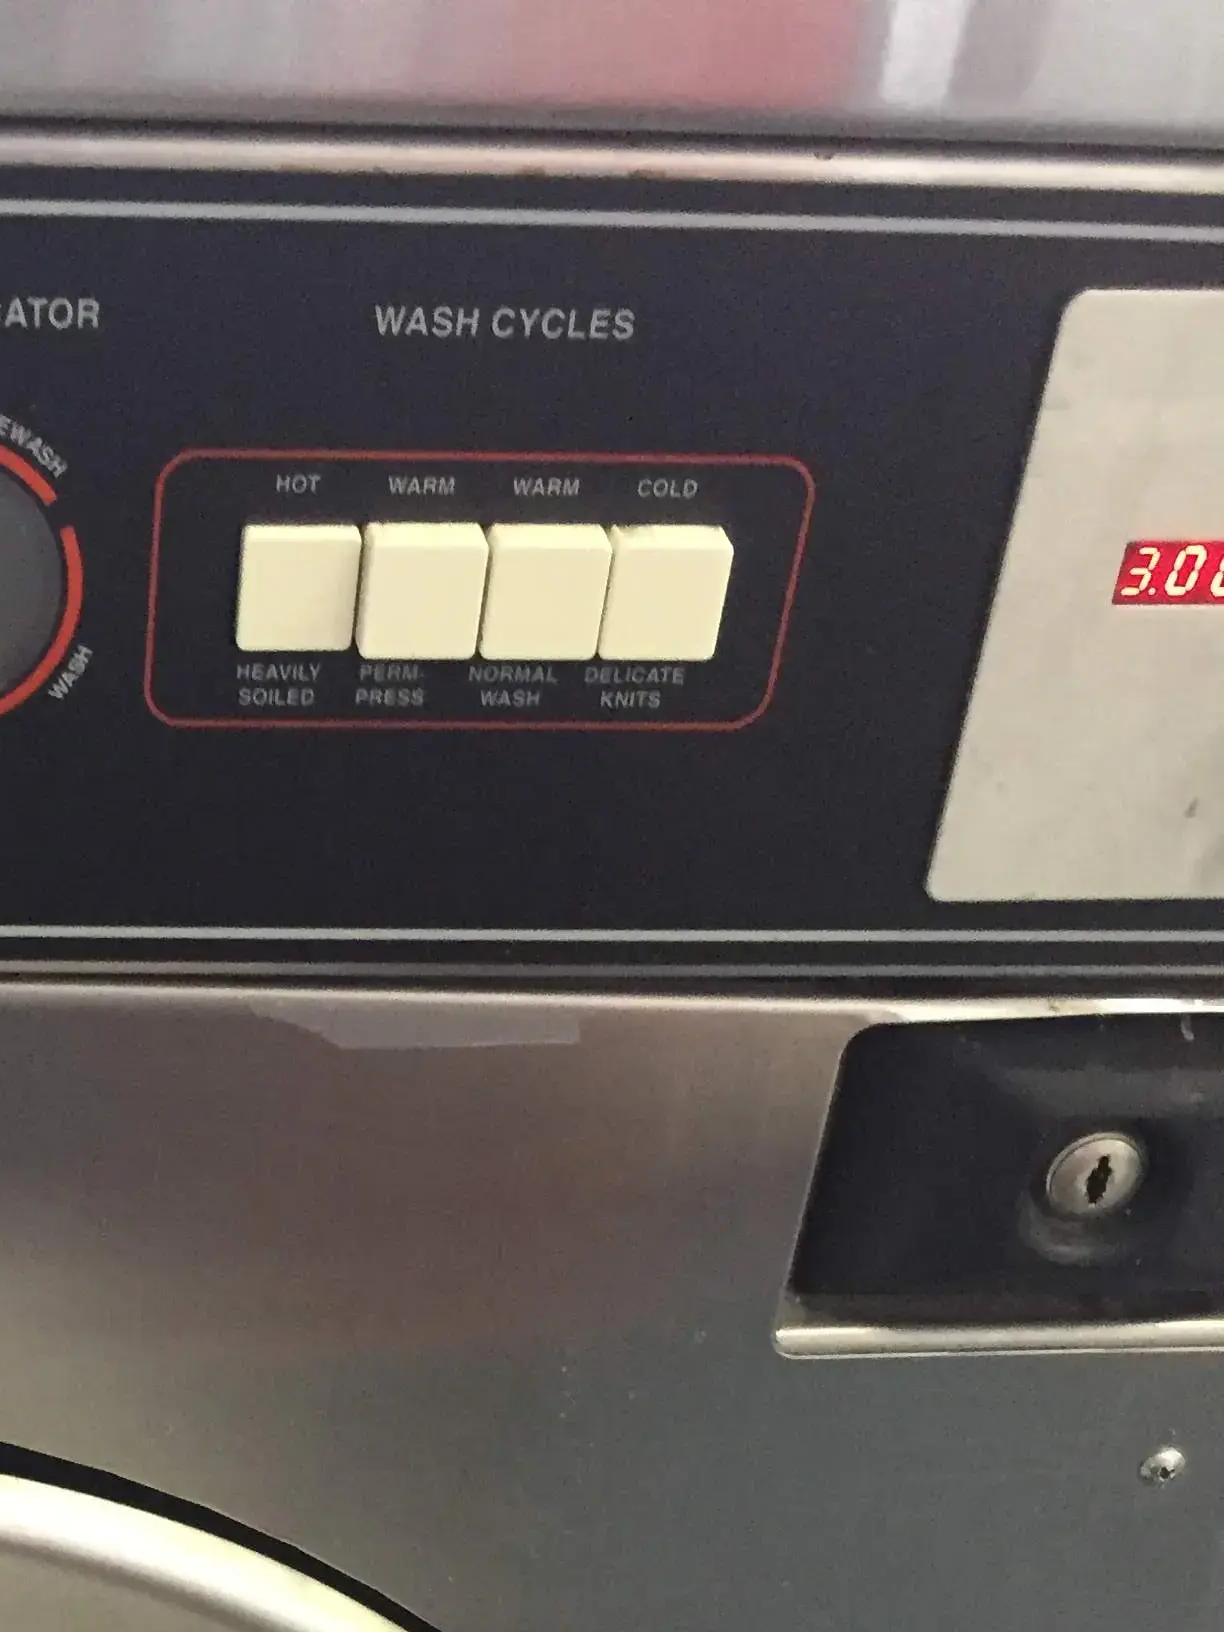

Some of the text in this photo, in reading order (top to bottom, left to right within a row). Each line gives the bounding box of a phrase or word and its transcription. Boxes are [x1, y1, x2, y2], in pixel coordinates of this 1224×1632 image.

[374, 305, 636, 341] WASH CYCLES
[276, 473, 321, 495] HOT
[388, 475, 456, 496] WARM
[513, 476, 580, 497] WARM
[637, 478, 698, 499] COLD
[47, 644, 94, 700] WASH
[236, 663, 322, 683] HEAVILY
[468, 664, 559, 684] NORMAL
[584, 666, 686, 686] DELICATE
[238, 688, 316, 707] SOILED
[355, 689, 425, 708] PRESS
[480, 690, 541, 709] WASH
[599, 691, 662, 709] KNITS
